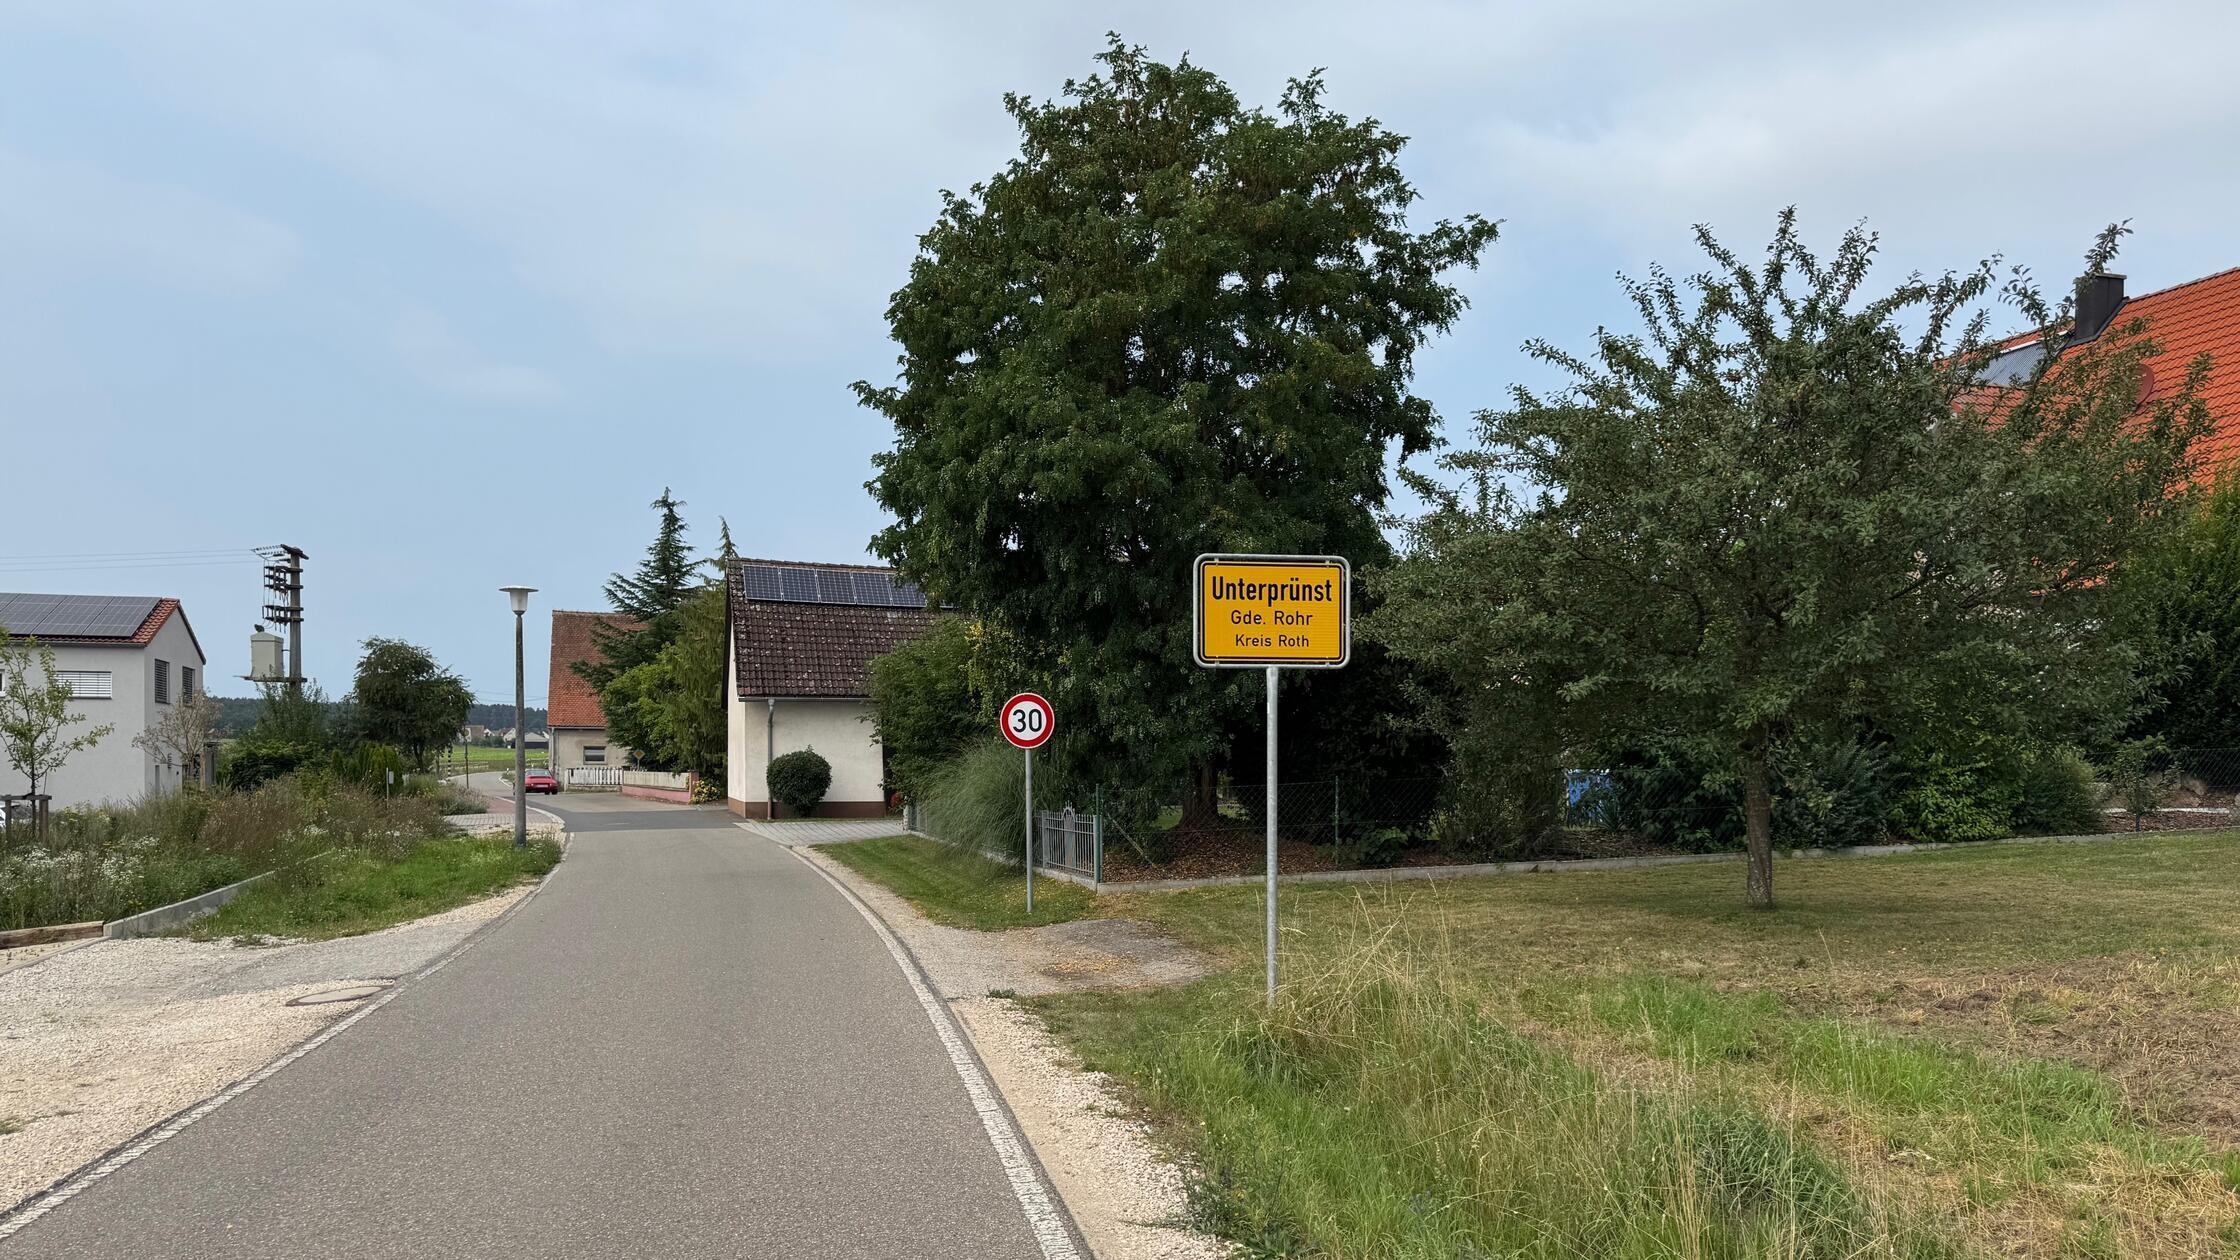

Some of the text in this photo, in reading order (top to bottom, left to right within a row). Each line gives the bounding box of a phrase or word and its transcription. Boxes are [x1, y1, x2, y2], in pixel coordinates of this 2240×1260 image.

[1212, 576, 1332, 607] Unterprünst
[1231, 610, 1313, 625] Gde. Rohr
[1235, 634, 1309, 647] Kreis Roth
[1013, 709, 1042, 732] 30
